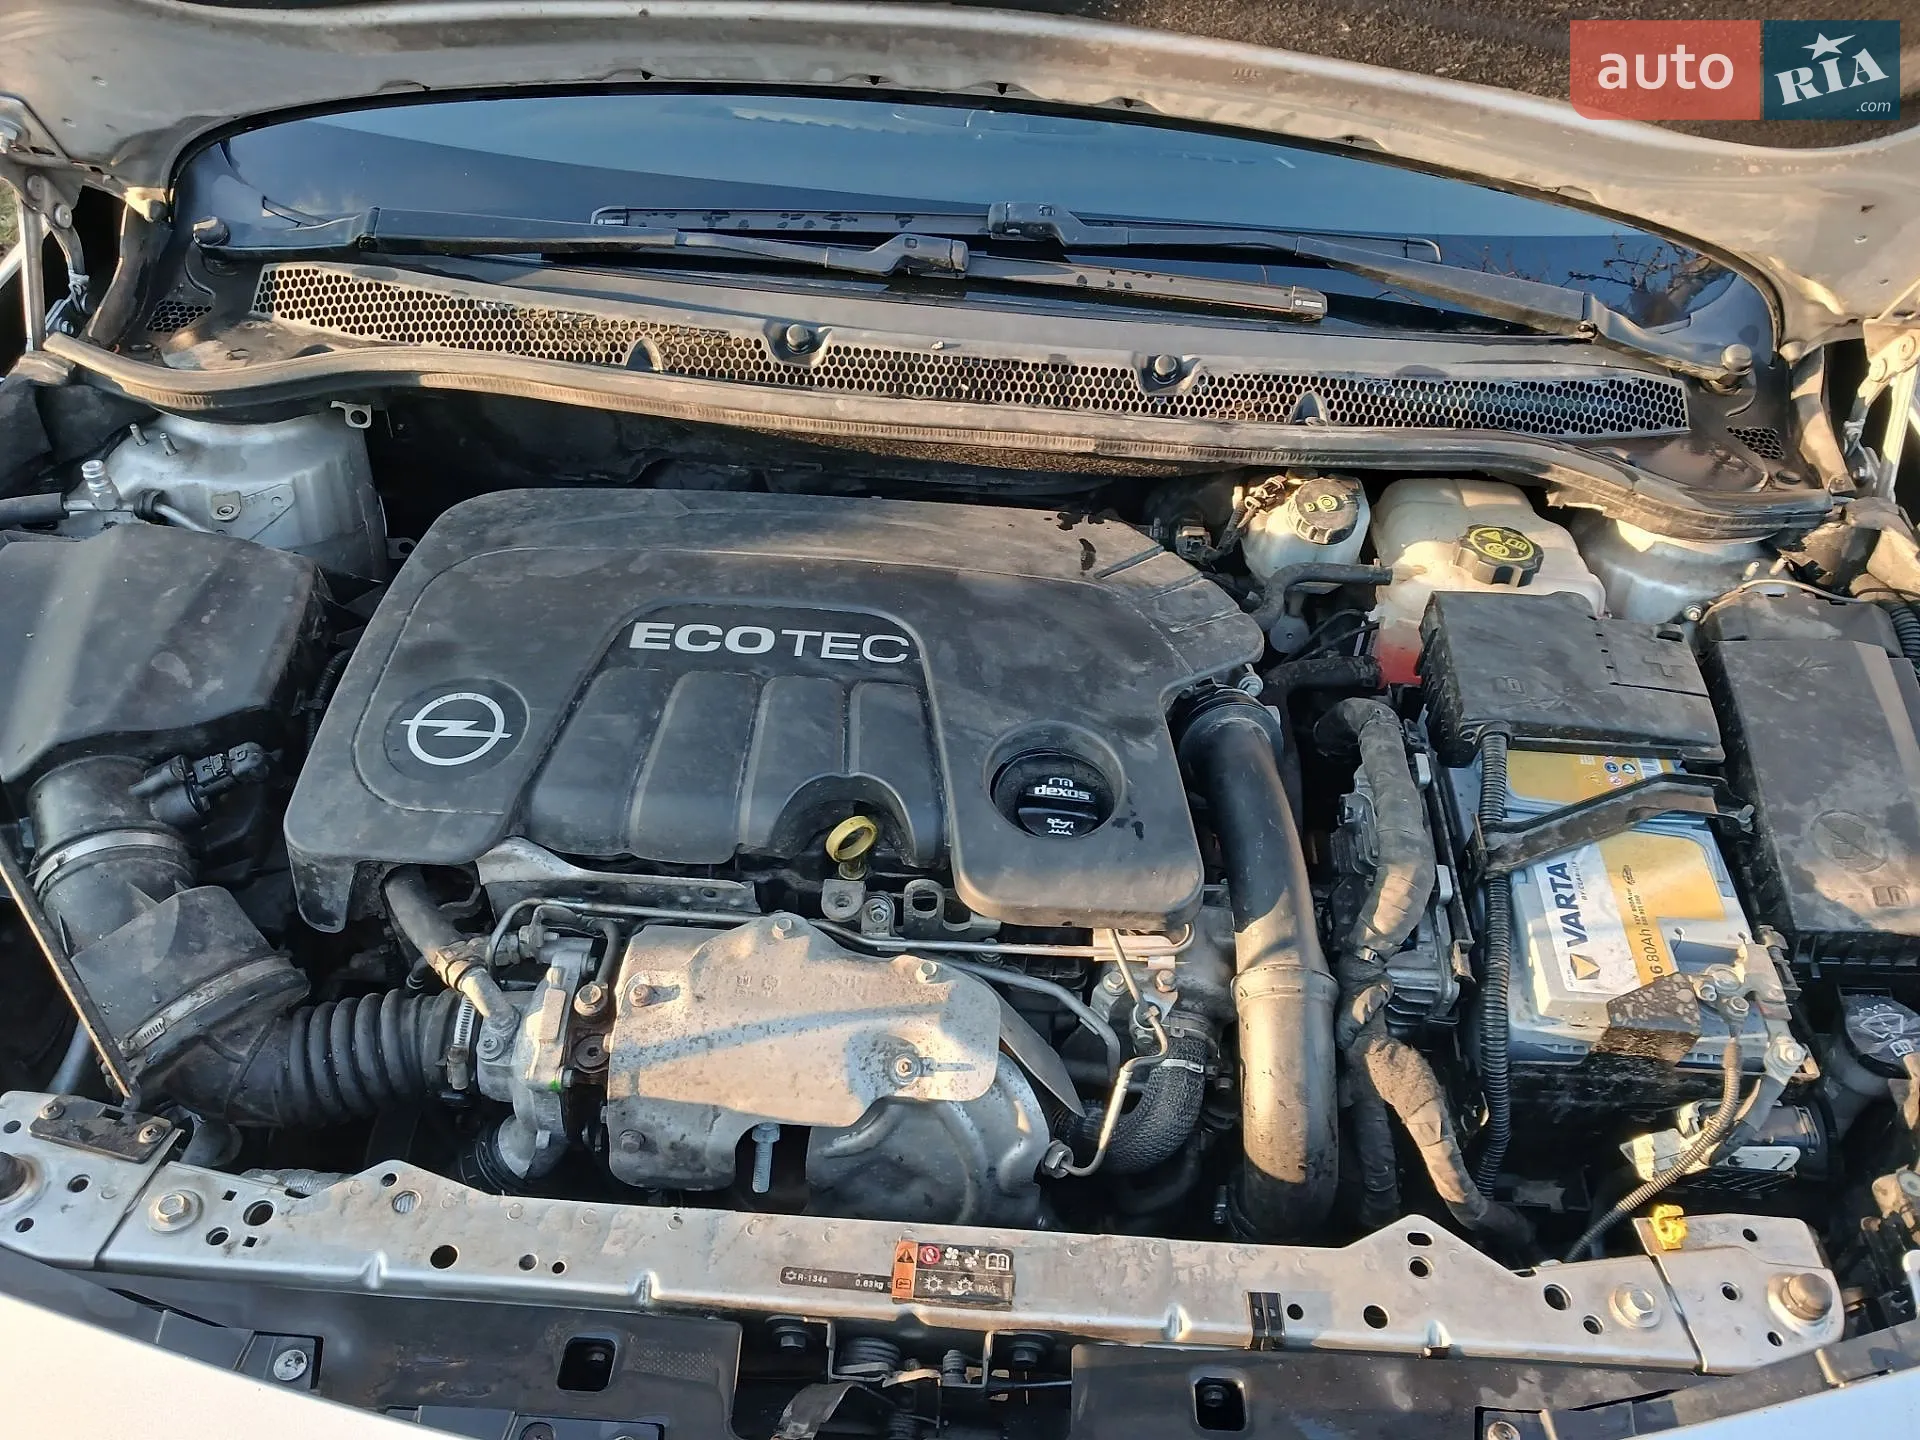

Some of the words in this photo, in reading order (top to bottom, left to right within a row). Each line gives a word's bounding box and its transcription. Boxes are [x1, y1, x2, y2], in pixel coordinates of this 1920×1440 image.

[628, 621, 910, 664] ECOTEC
[1034, 784, 1092, 801] dexos
[1546, 861, 1588, 948] VARTA
[1639, 928, 1661, 962] 80Ah
